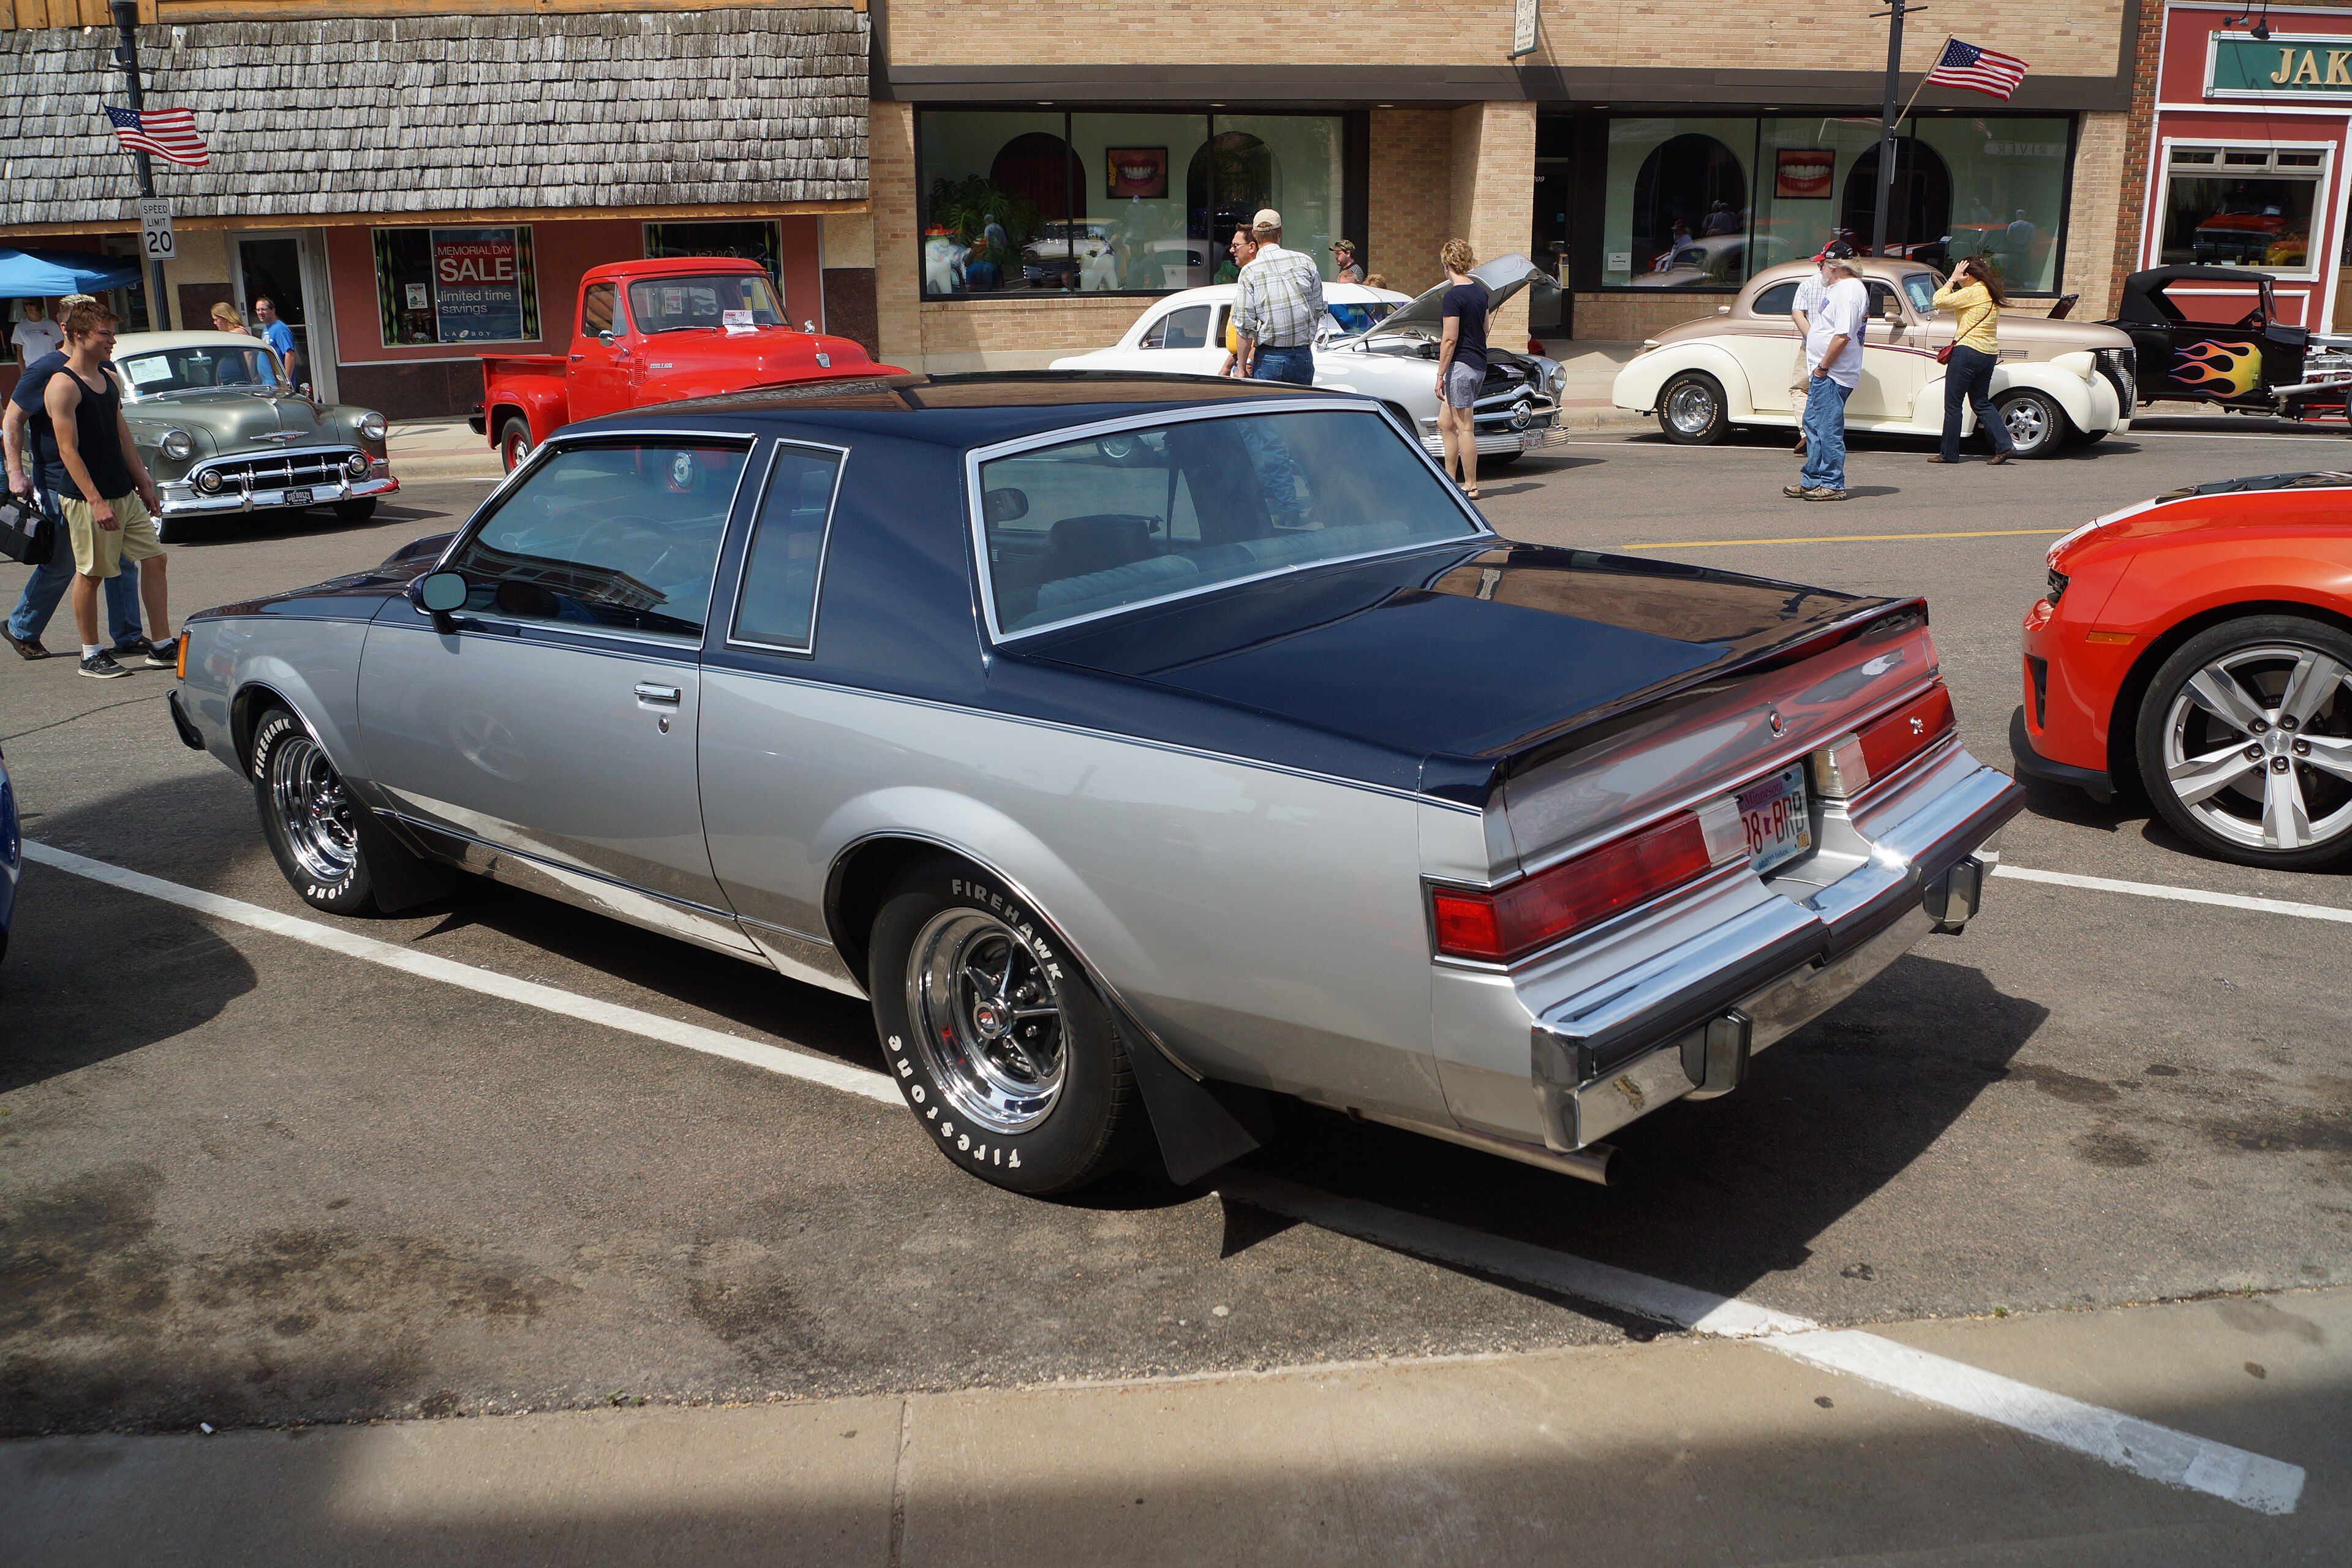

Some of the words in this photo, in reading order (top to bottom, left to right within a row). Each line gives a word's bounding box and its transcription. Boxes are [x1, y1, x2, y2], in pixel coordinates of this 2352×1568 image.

[2271, 48, 2352, 85] JAK
[143, 204, 167, 214] SPEED
[147, 218, 166, 227] LIMIT
[146, 231, 172, 252] 20
[437, 246, 491, 255] MEMORIAL
[493, 246, 511, 254] DAY
[439, 258, 514, 282] SALE
[440, 290, 481, 302] limited
[484, 290, 511, 301] time
[442, 303, 488, 315] savings
[255, 718, 292, 779] FIREHAWK
[1744, 782, 1783, 807] Minnesota
[952, 879, 1063, 981] FIREHAWK
